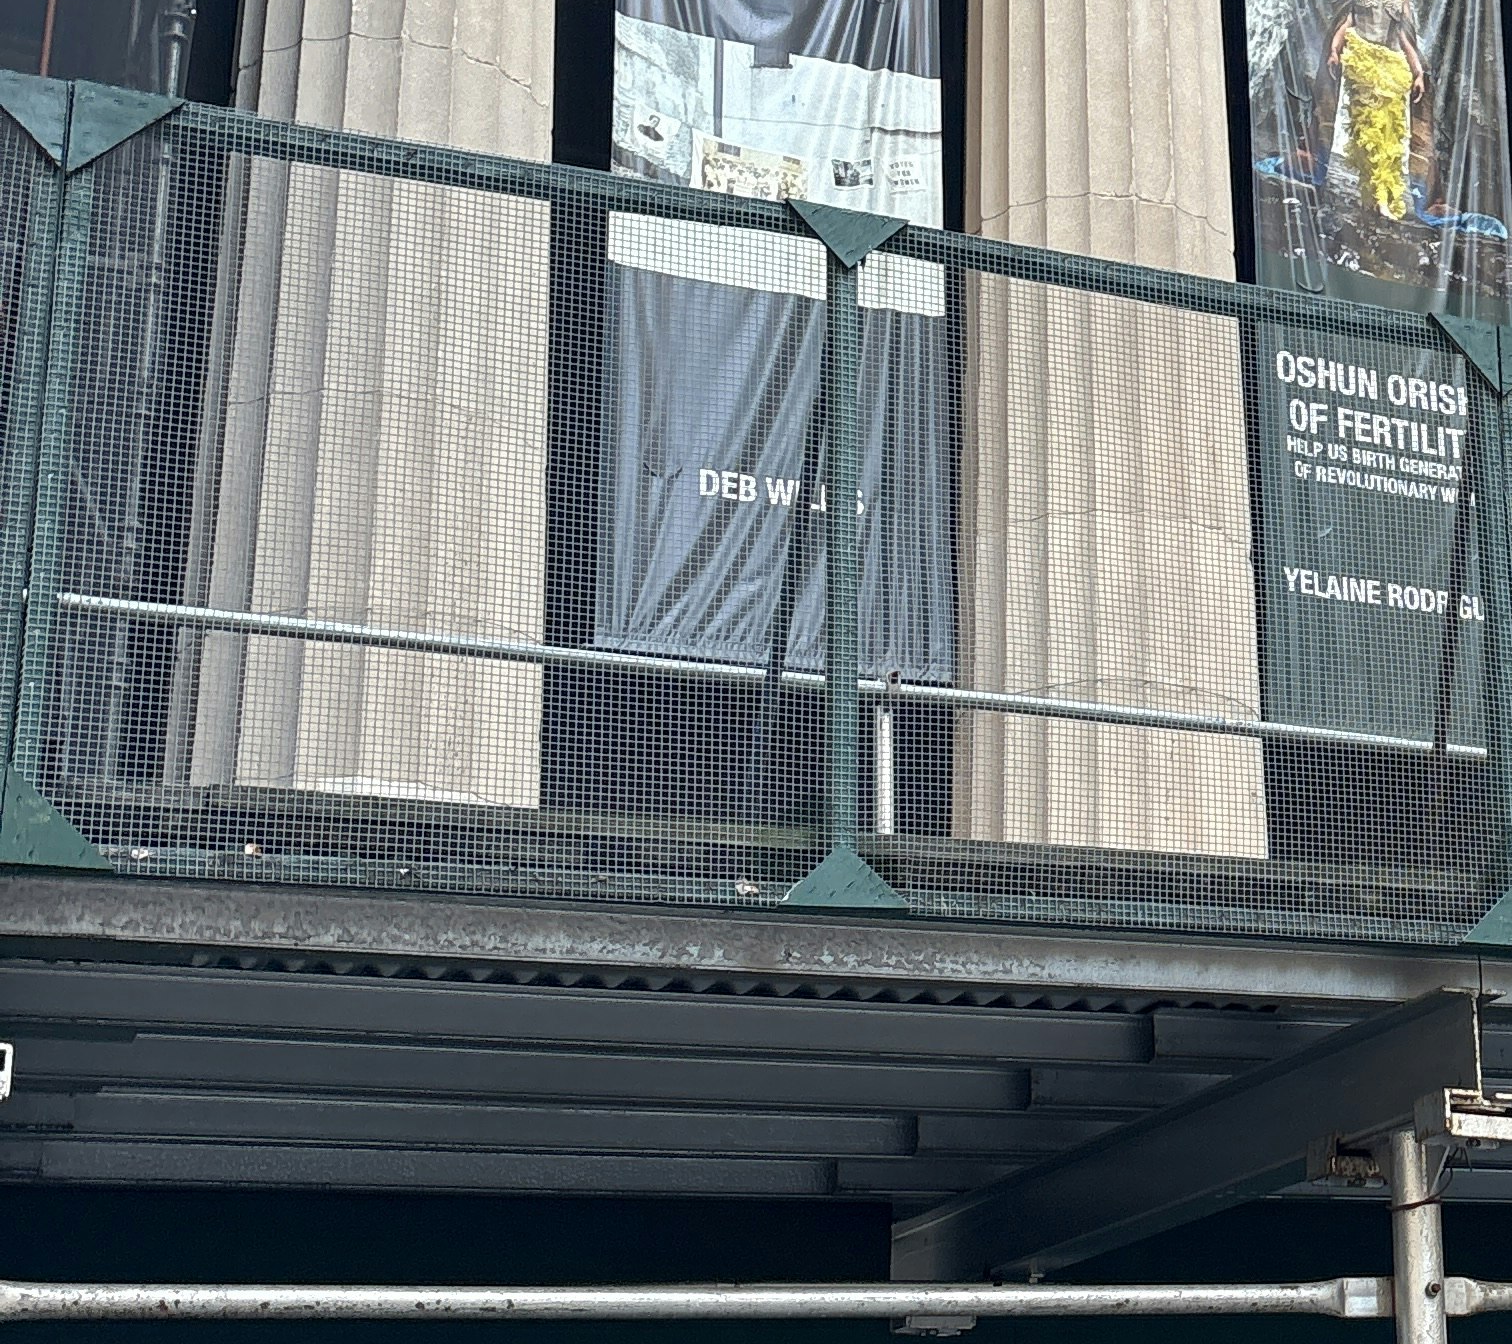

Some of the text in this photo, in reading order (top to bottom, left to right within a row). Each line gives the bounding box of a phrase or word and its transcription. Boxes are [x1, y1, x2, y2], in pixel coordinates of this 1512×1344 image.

[1276, 350, 1378, 400] OSHUN
[1289, 398, 1329, 434] OF
[1286, 434, 1323, 457] HELP
[1327, 443, 1348, 462] US
[1352, 448, 1396, 471] BIRTH
[699, 468, 757, 502] DEB
[1294, 460, 1312, 480] OF
[1315, 465, 1437, 501] REVOLUTIONARY
[1284, 566, 1382, 606] YELAINE
